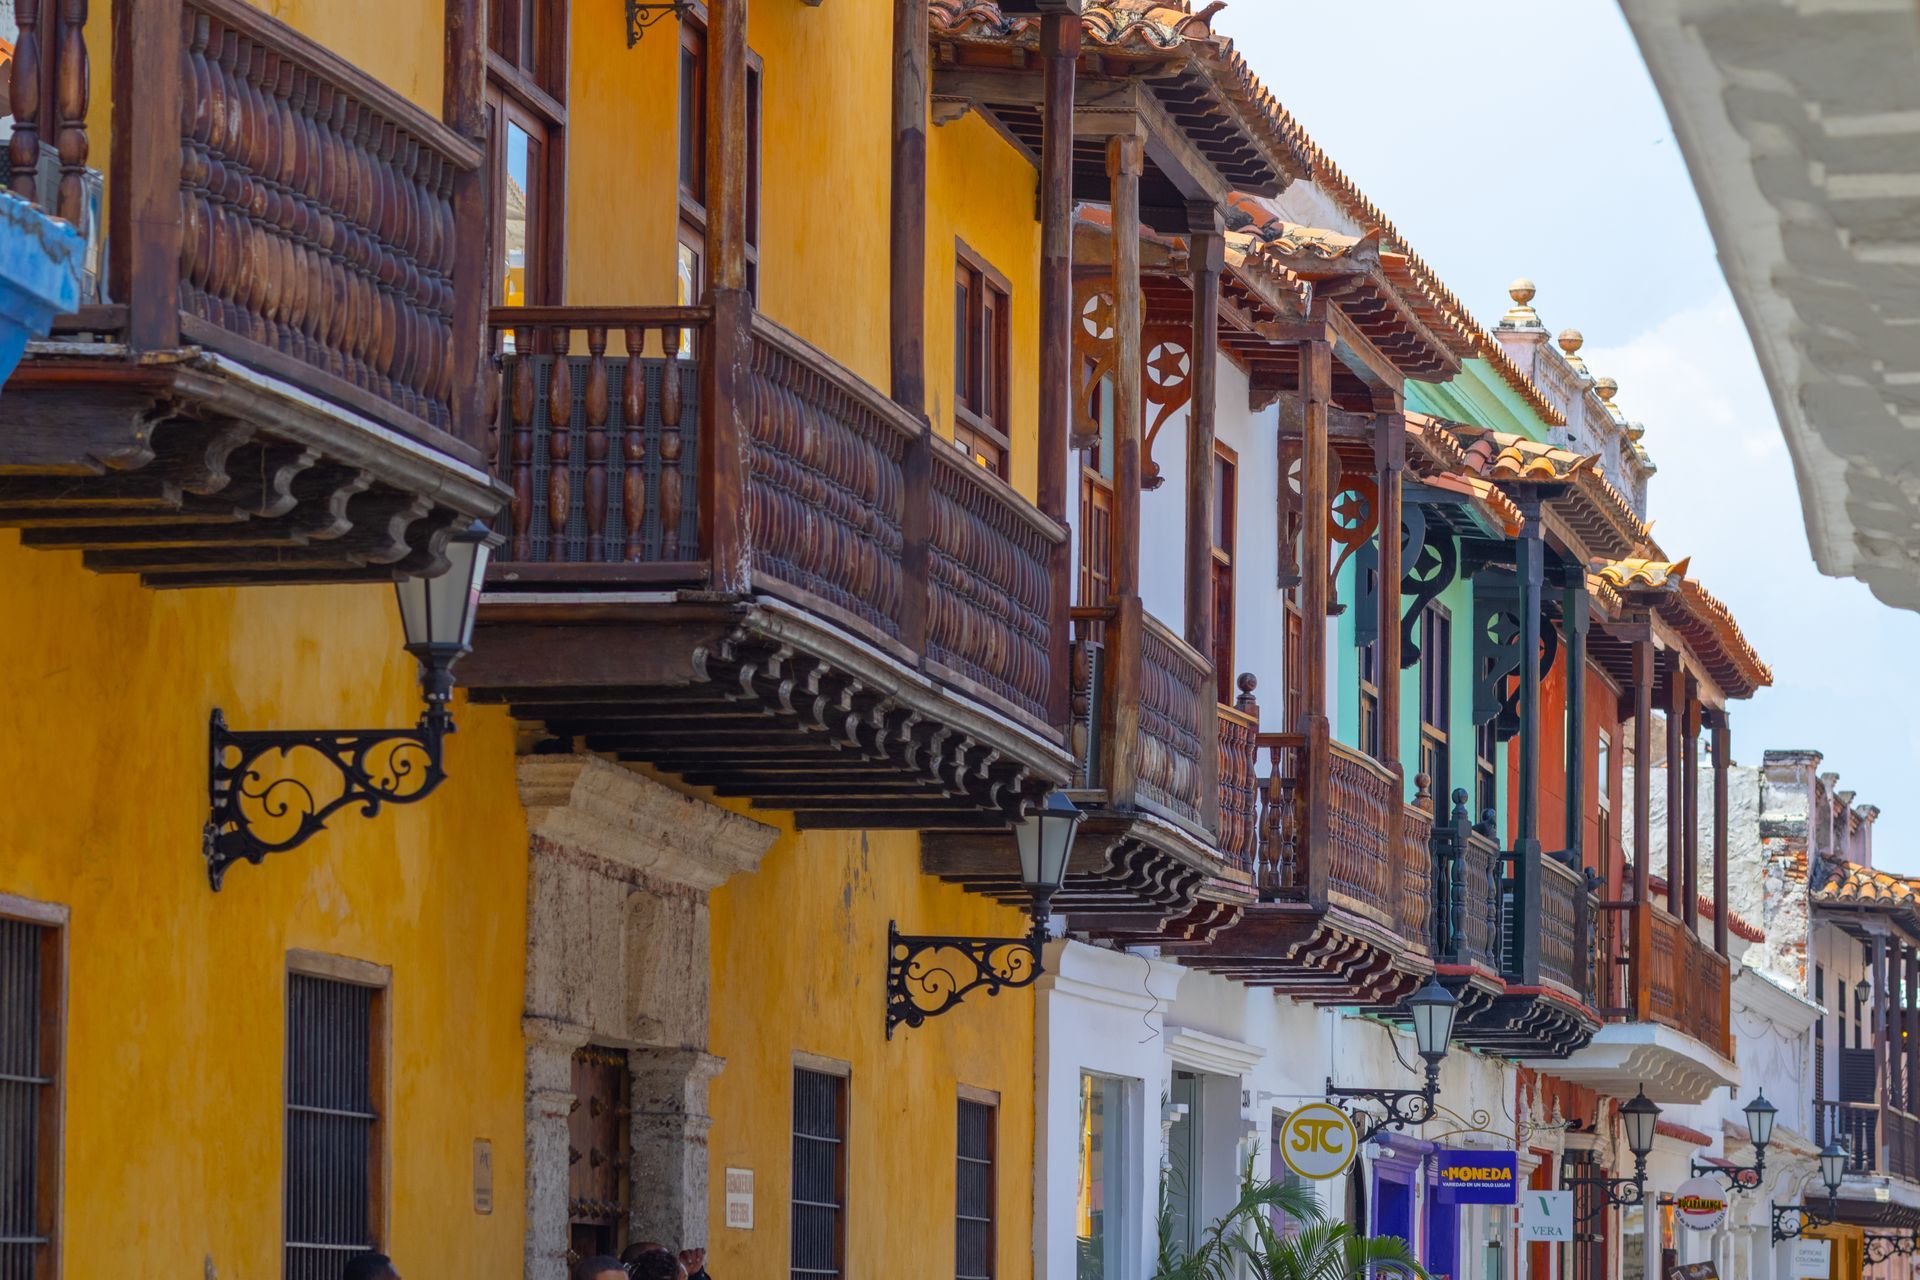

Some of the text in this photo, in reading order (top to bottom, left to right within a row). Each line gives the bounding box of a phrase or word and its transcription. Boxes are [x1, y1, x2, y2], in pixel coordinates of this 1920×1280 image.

[1291, 1118, 1344, 1154] STC
[1448, 1166, 1512, 1181] MONEDA
[1677, 1198, 1723, 1211] BUCARAMANGA
[1532, 1226, 1563, 1236] VERA
